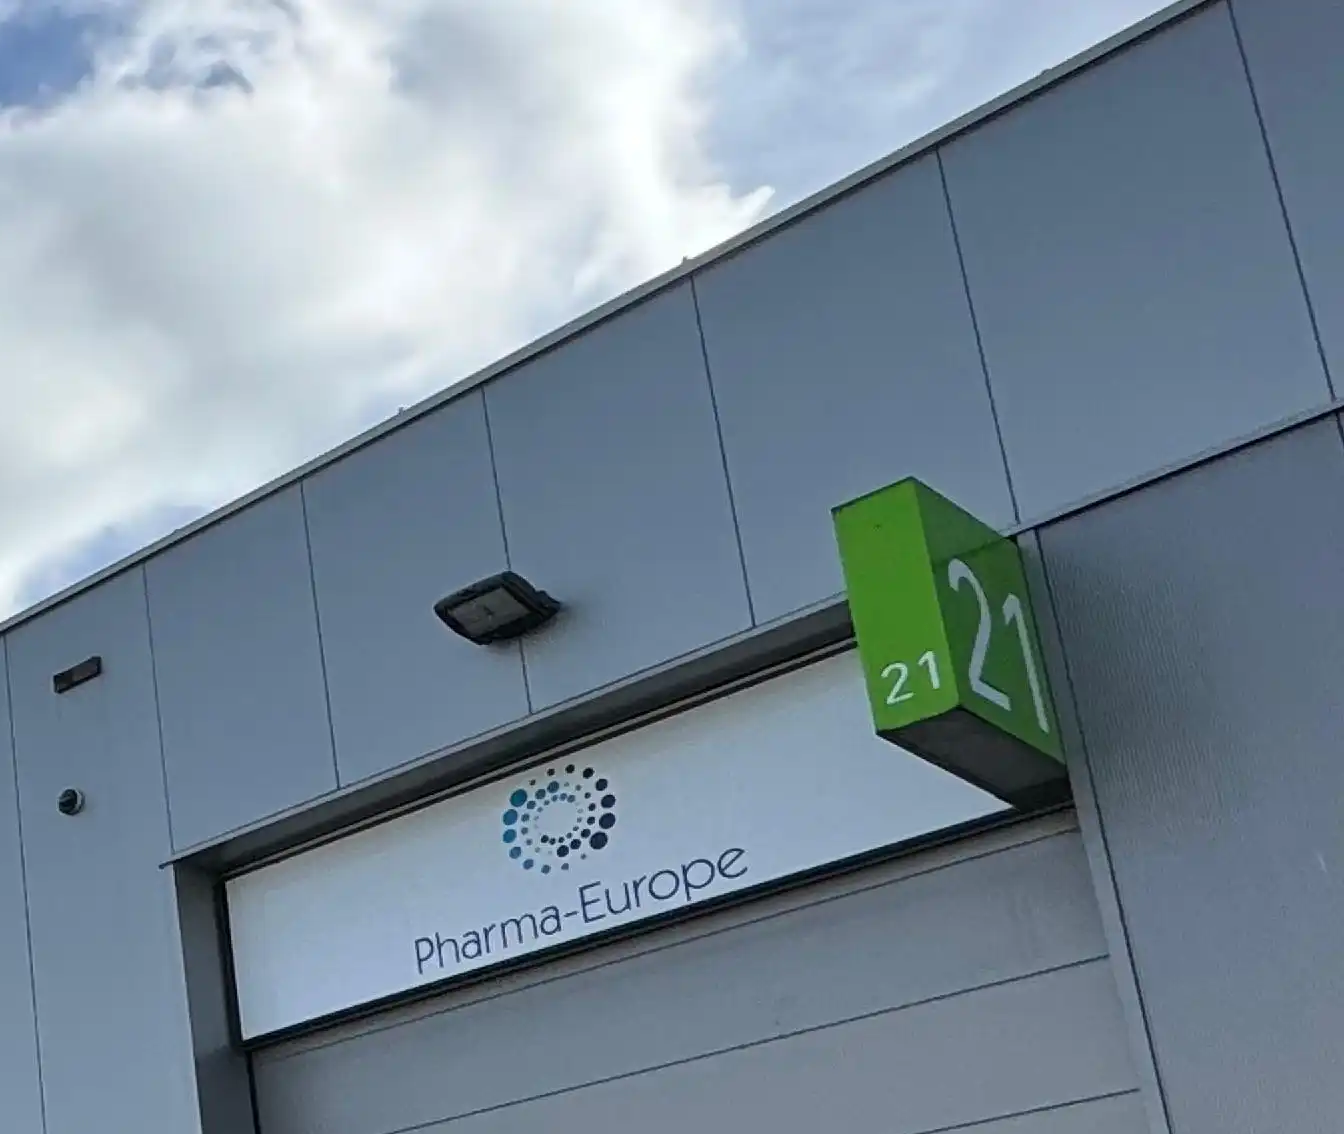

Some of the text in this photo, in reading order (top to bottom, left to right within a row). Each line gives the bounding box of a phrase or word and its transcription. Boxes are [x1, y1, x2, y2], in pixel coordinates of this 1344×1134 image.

[880, 650, 941, 706] 21
[948, 558, 1050, 734] 21
[413, 847, 749, 976] Pharma-Europe
